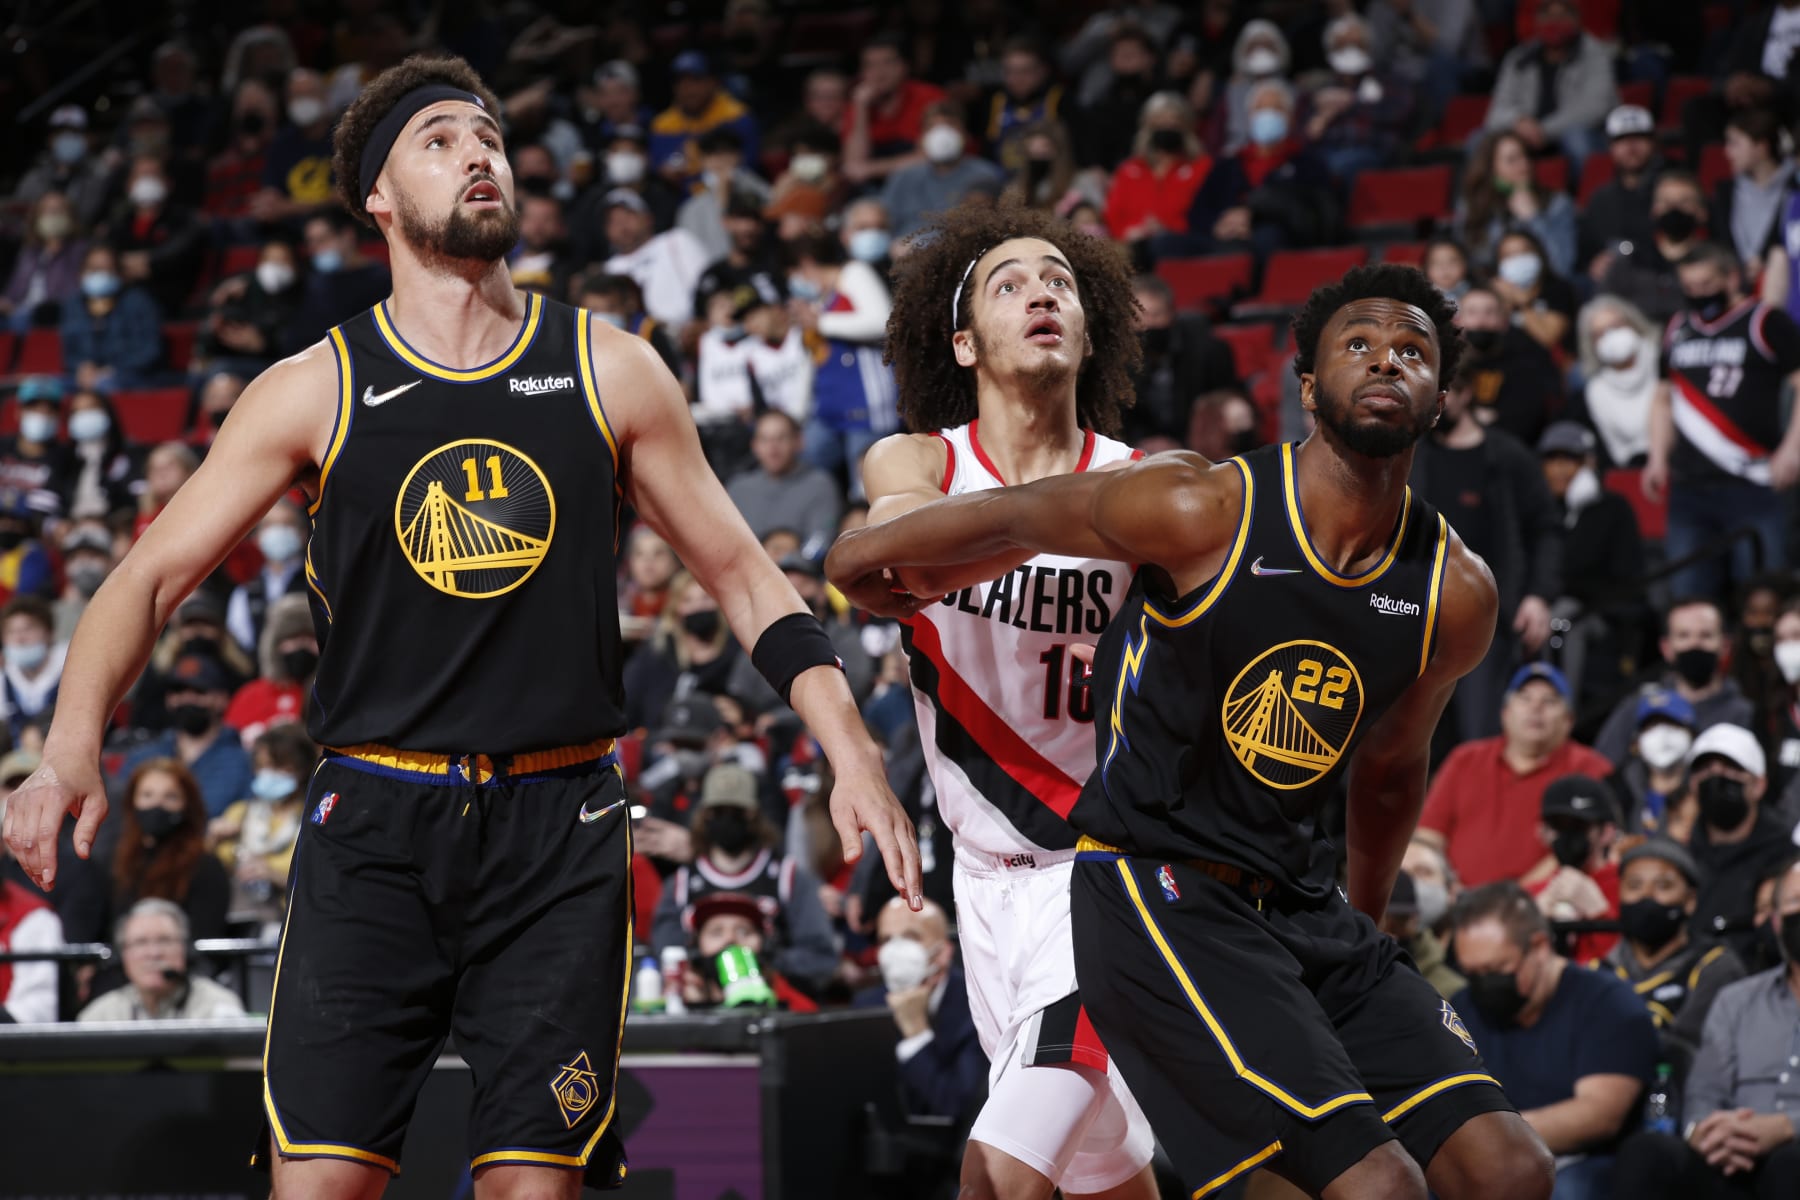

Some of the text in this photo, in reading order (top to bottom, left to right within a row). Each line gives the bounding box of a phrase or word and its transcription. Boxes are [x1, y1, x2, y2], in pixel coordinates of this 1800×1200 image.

[509, 375, 574, 394] Rakuten
[462, 455, 508, 502] 11
[940, 565, 1112, 634] LAZERS
[1369, 593, 1420, 616] Rakuten
[1291, 659, 1352, 710] 22
